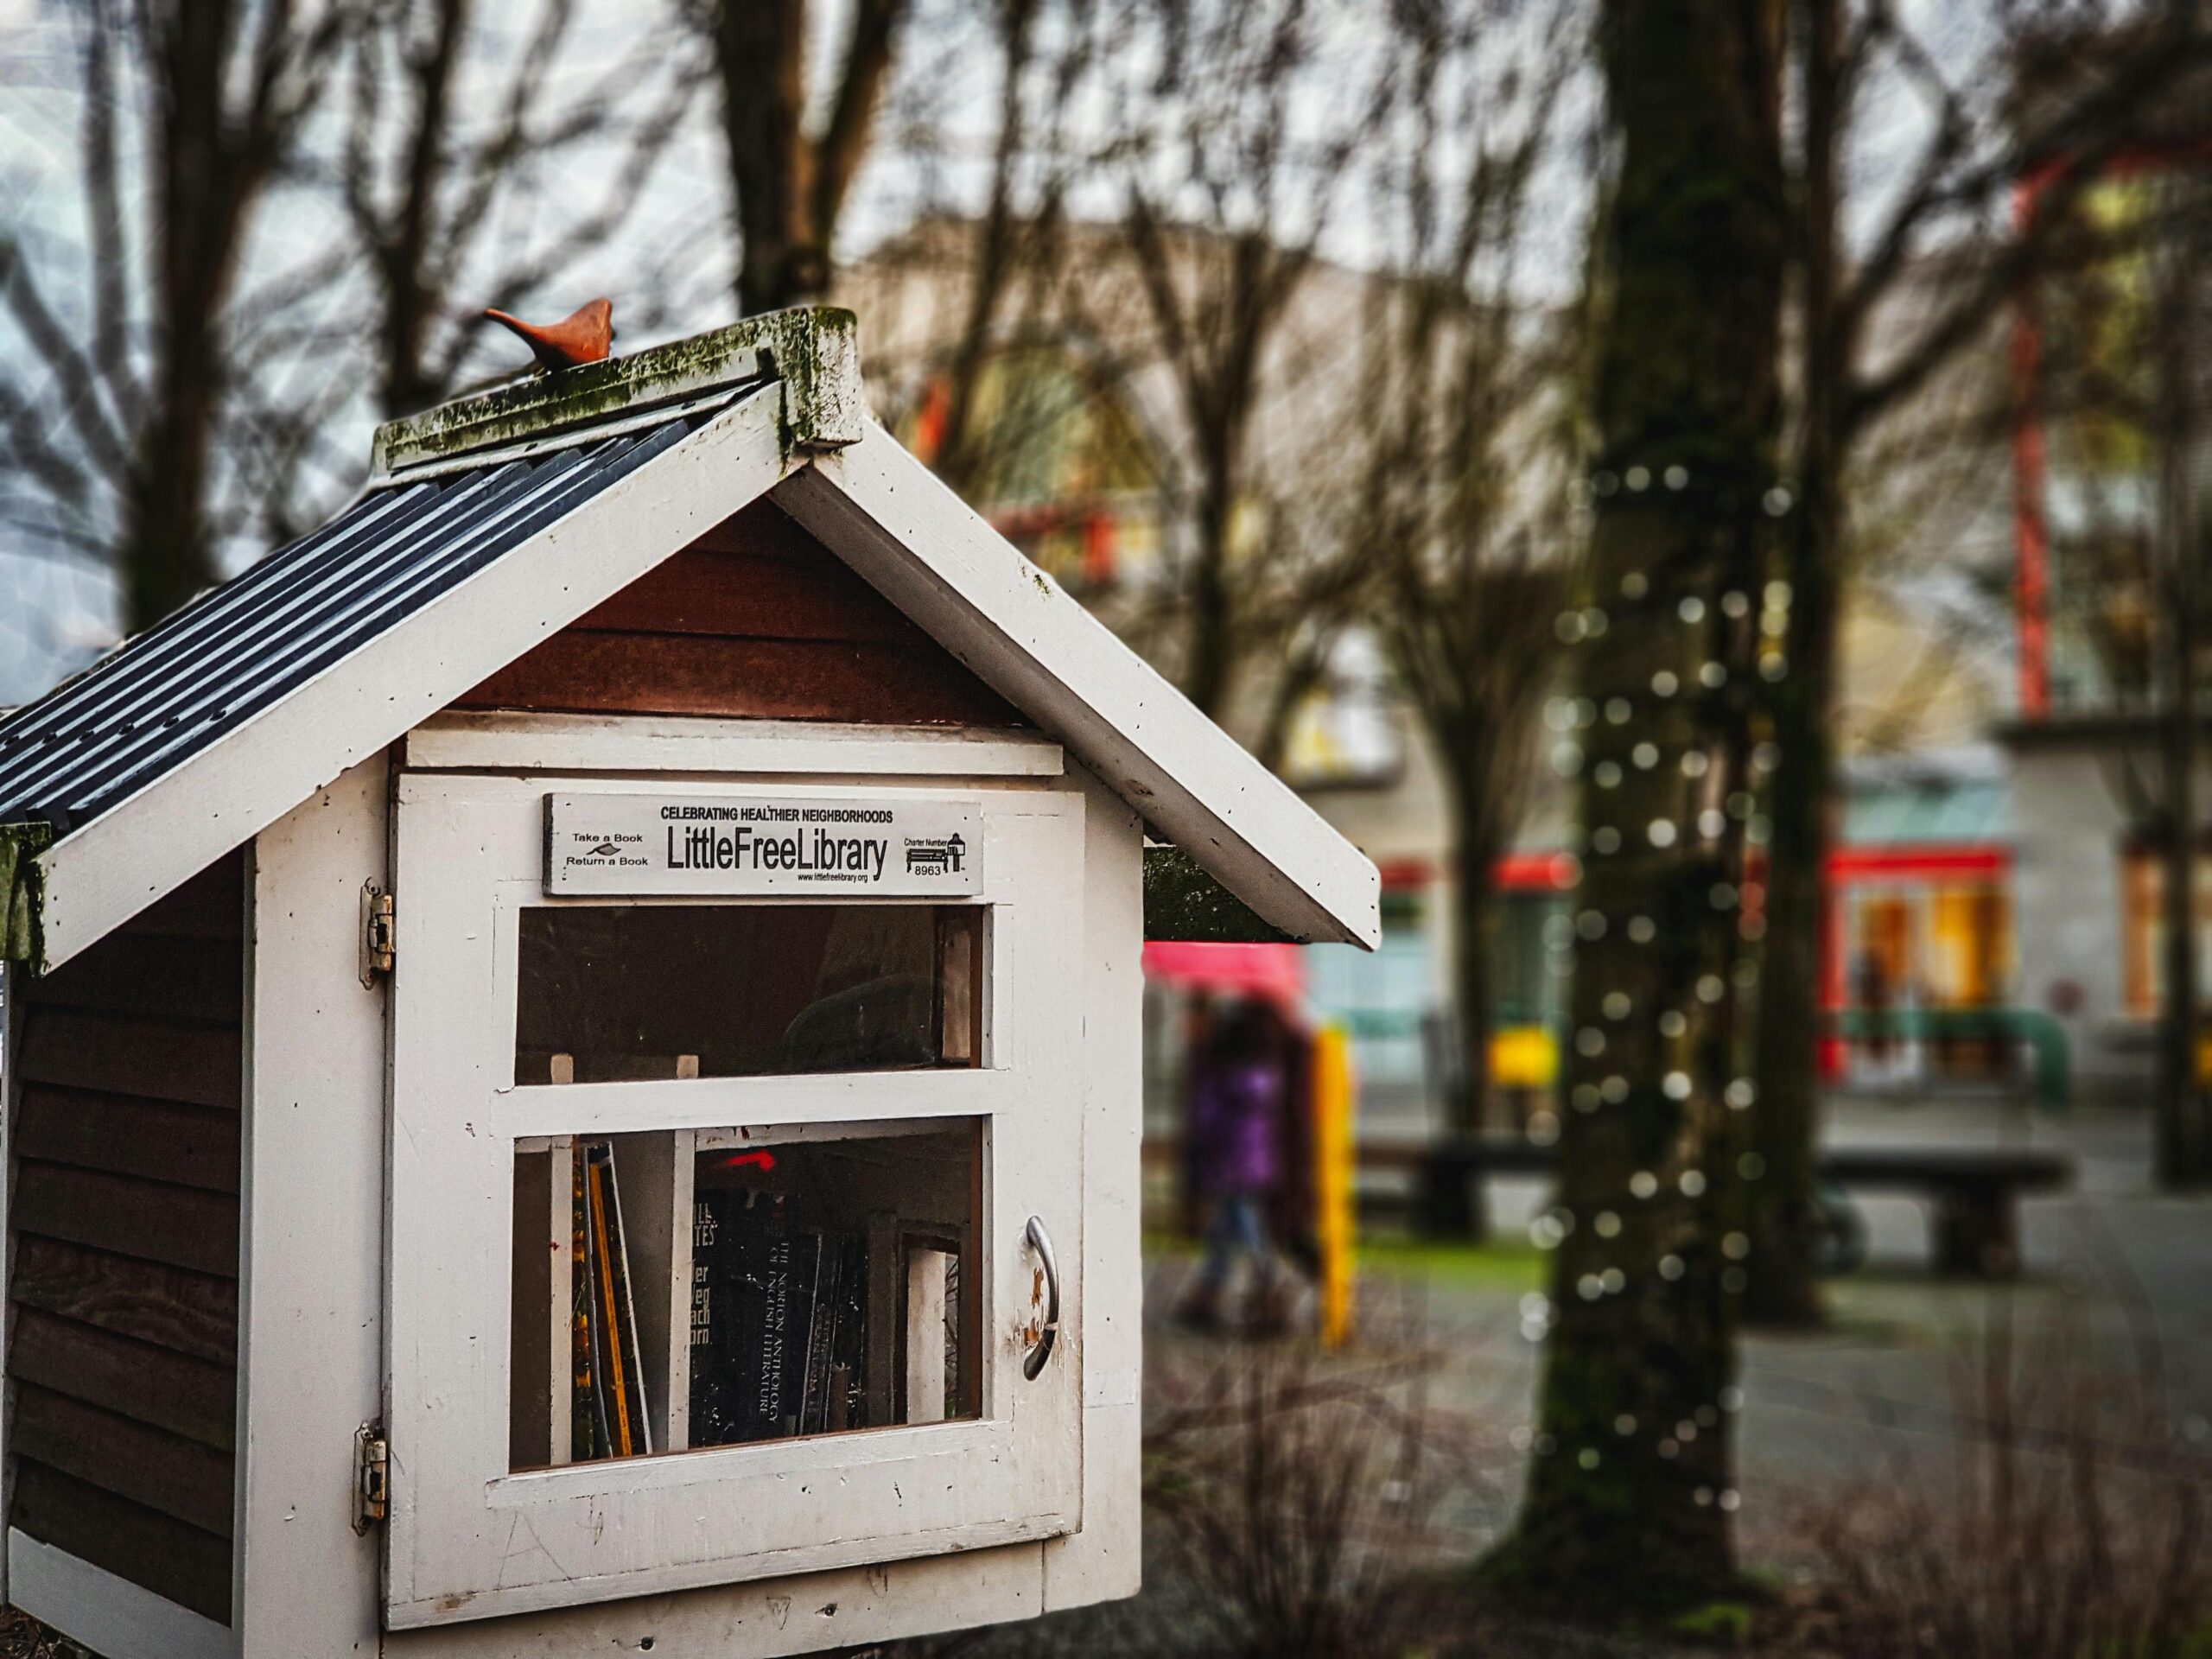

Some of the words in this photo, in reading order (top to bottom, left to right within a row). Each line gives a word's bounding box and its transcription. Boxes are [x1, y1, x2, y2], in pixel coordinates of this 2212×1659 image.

[661, 806, 738, 820] CELEBRATING
[741, 807, 799, 822] HEALTHIER
[802, 809, 893, 823] NEIGHBORHOODS
[572, 833, 600, 842] Take
[614, 834, 643, 842] Book
[904, 837, 925, 847] Charter
[925, 838, 947, 847] Number
[667, 826, 888, 881] LittleFreeLibrary
[566, 856, 605, 866] Return
[620, 857, 648, 866] Book
[914, 865, 941, 876] 8963
